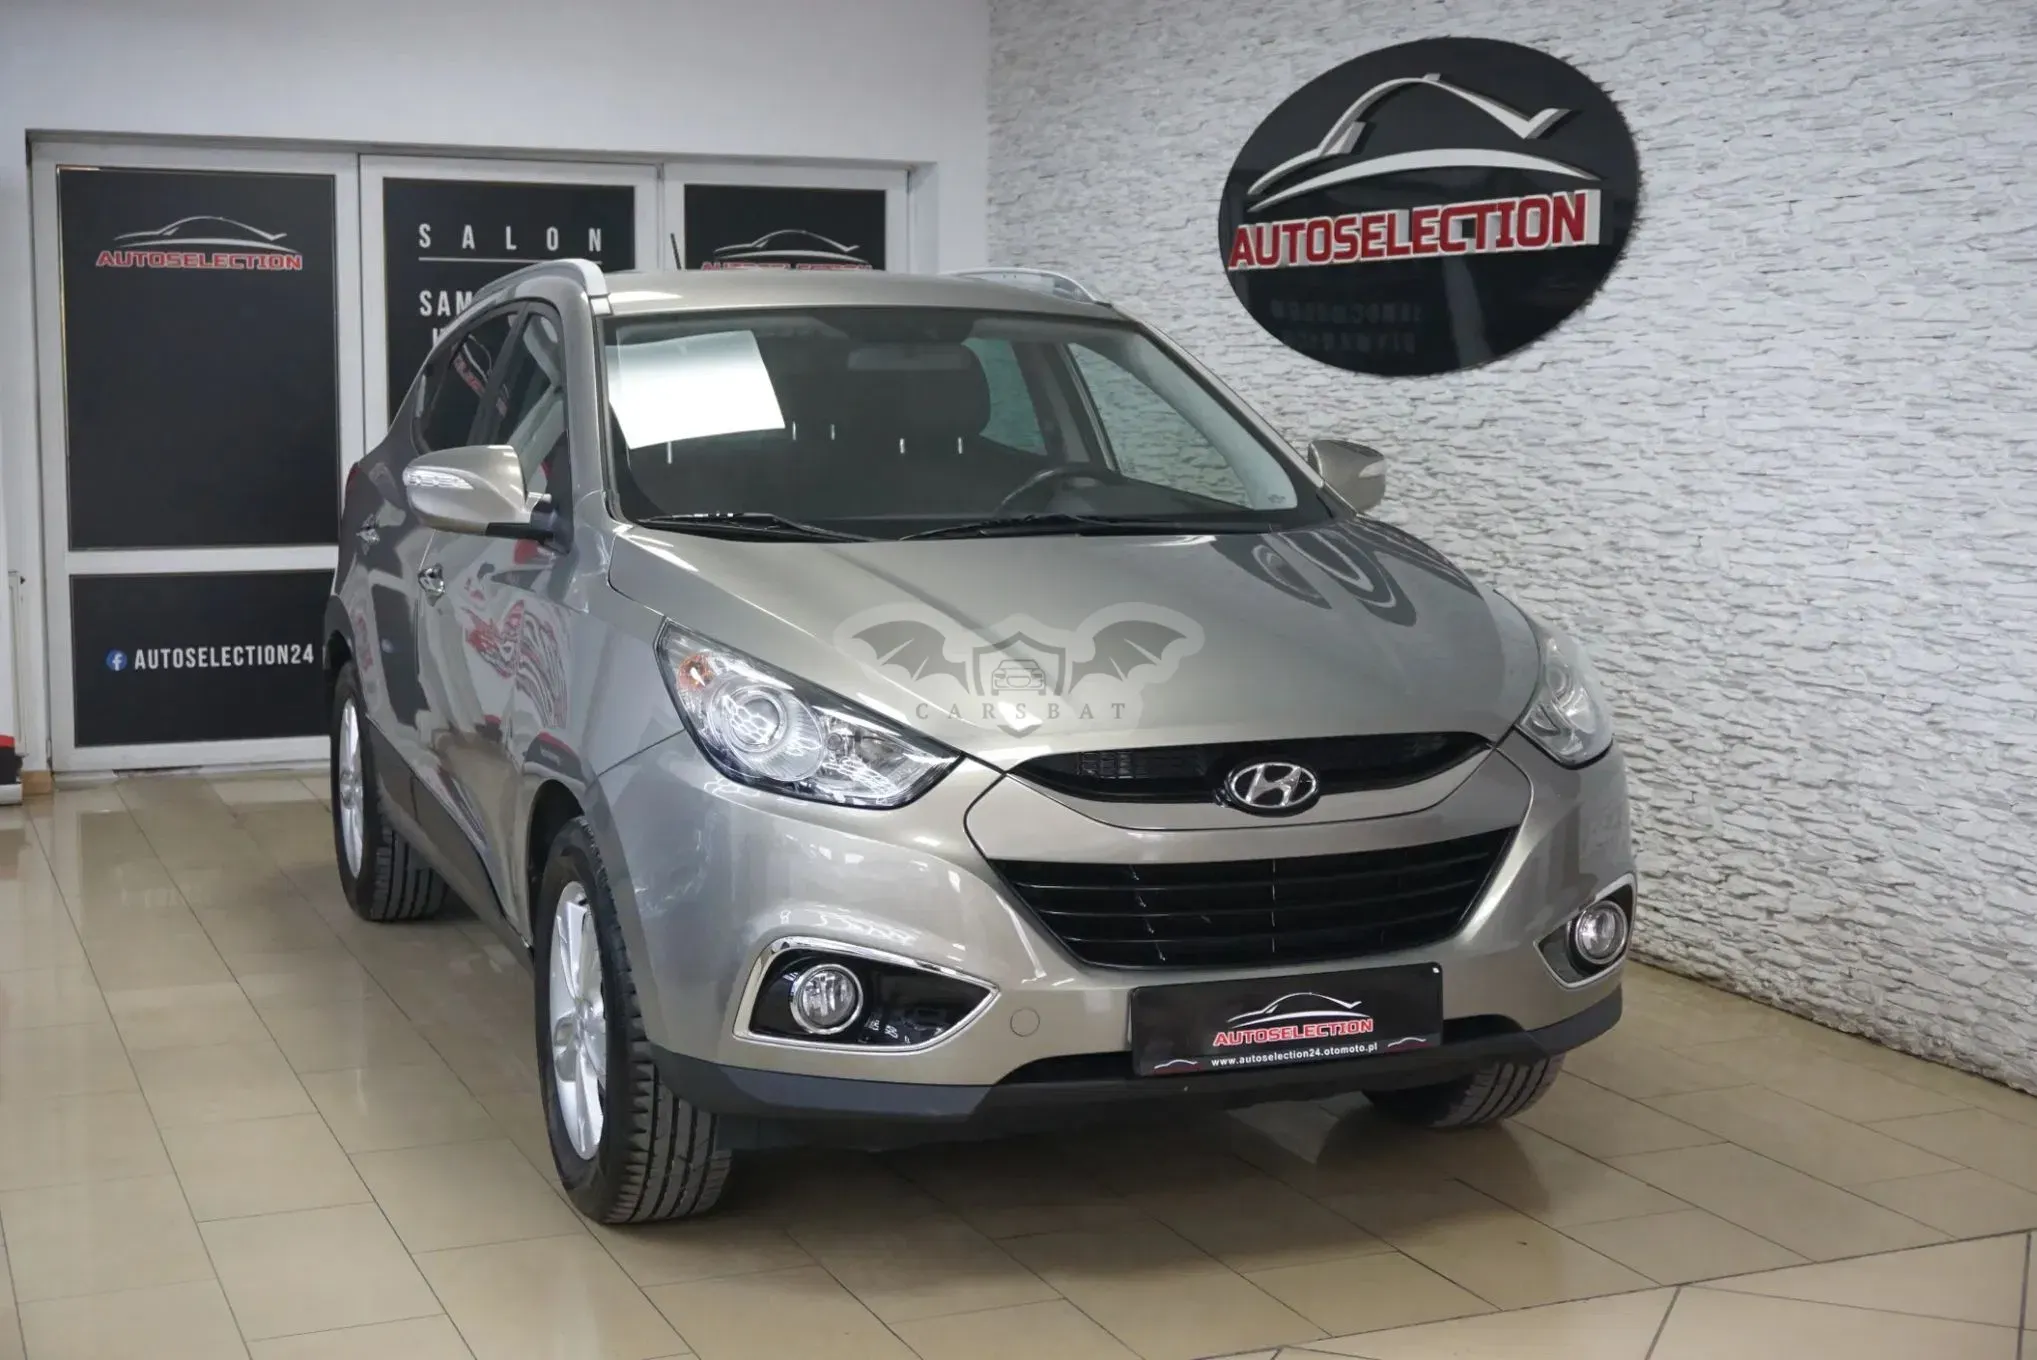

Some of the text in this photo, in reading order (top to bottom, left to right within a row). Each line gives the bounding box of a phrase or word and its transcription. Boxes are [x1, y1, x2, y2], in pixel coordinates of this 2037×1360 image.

[418, 223, 601, 252] SALON
[1228, 189, 1601, 271] AUTOSELECTION
[96, 250, 303, 270] AUTOSELECTION
[134, 643, 314, 670] AUTOSELECTION24
[1213, 1018, 1374, 1047] AUTOSELECTION
[1211, 1042, 1378, 1068] www.autoselection24.otomoto.pl
